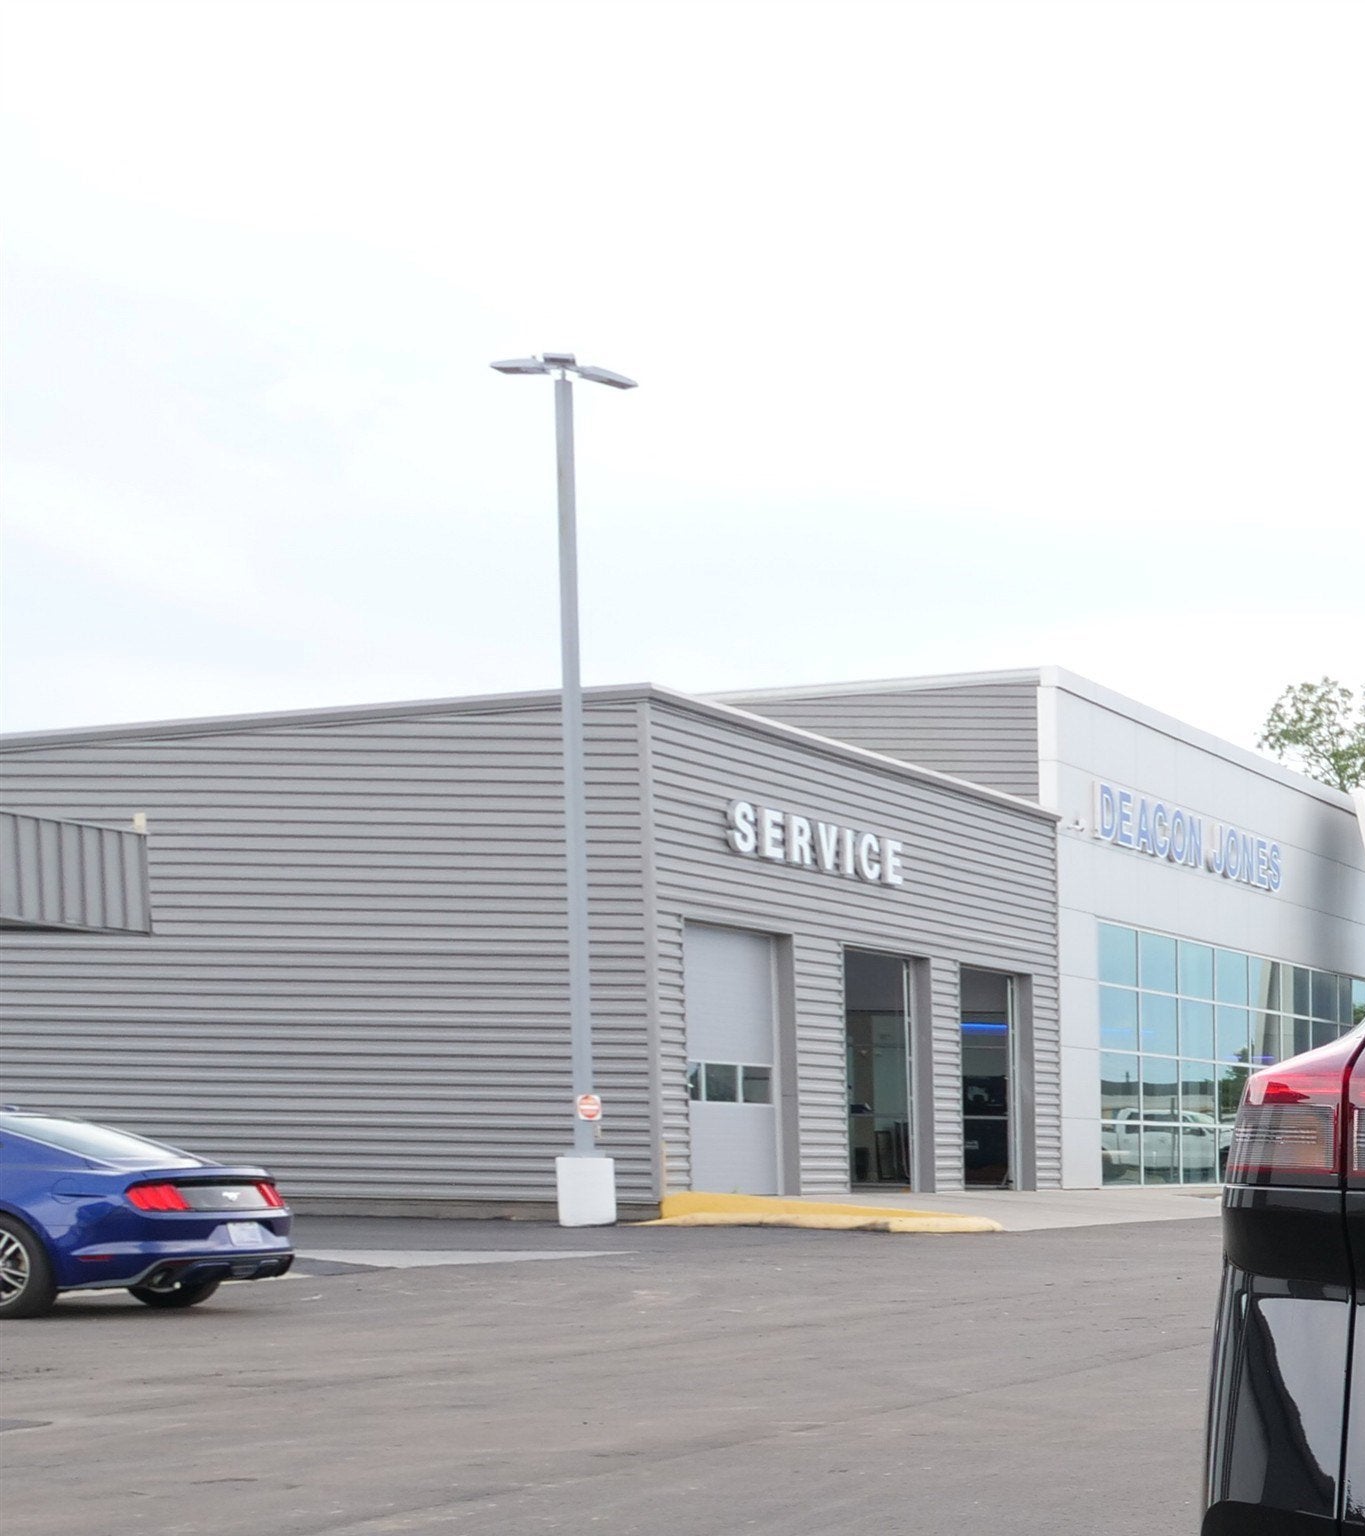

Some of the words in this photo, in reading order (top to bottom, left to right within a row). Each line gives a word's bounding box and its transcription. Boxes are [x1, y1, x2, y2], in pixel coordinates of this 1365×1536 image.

[726, 800, 904, 886] SERVICE
[1096, 780, 1204, 869] DEACON
[1209, 821, 1284, 894] JONES
